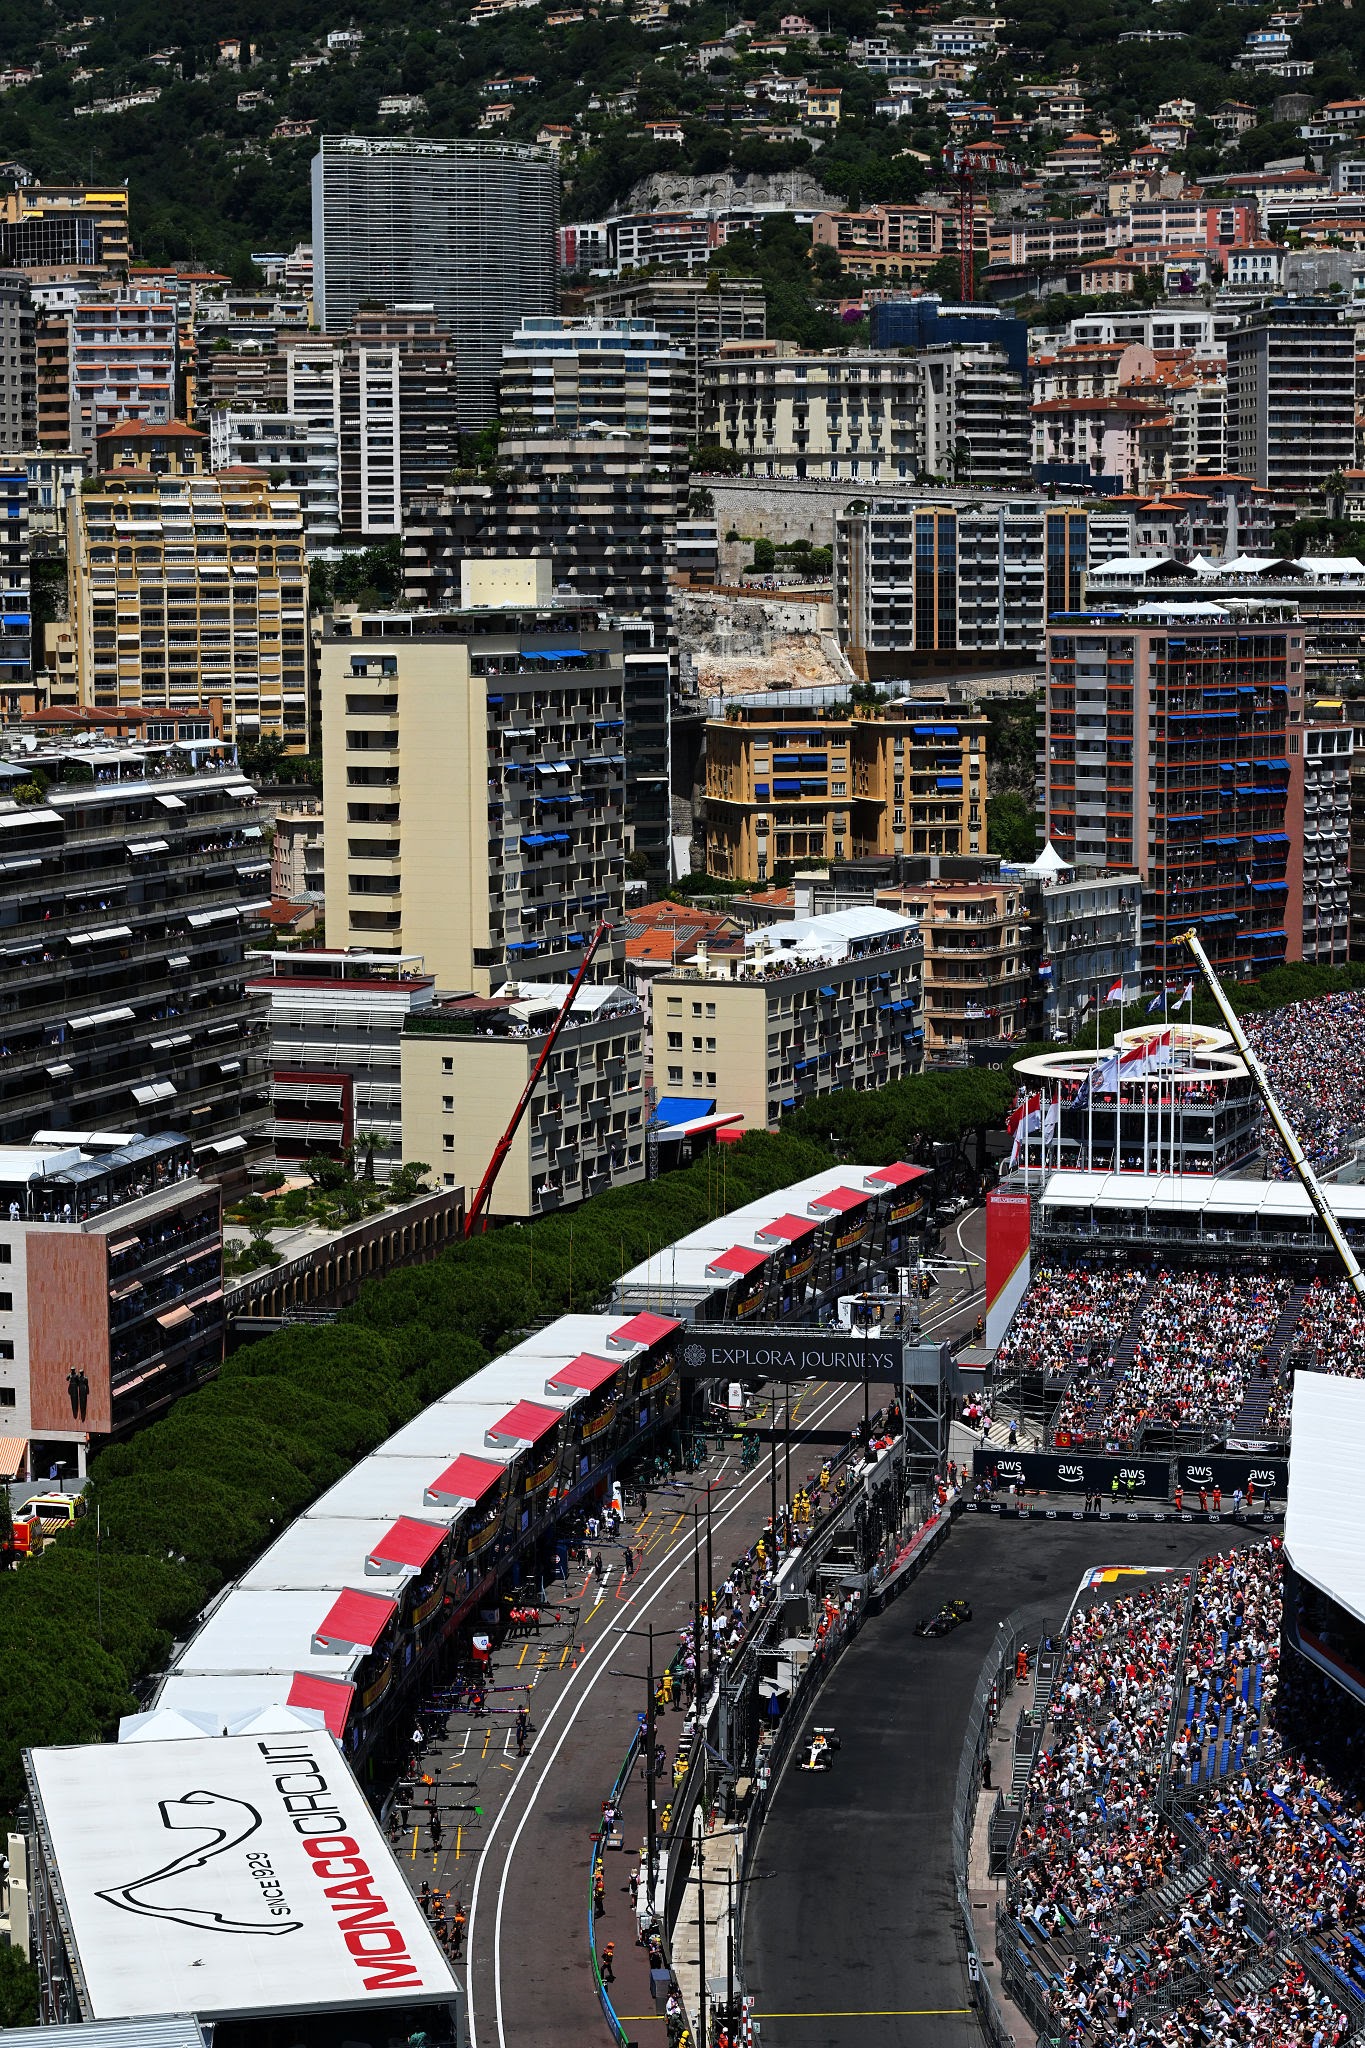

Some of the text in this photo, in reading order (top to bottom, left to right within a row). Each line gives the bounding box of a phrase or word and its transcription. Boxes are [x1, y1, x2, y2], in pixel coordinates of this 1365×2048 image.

[711, 1348, 894, 1370] EXPLORA JOURNEYS
[997, 1460, 1022, 1471] aws
[1058, 1465, 1083, 1476] aws
[1187, 1465, 1212, 1476] aws
[1120, 1468, 1145, 1480] aws
[1249, 1468, 1275, 1480] aws
[256, 1741, 424, 1991] MONACO CIRCUIT
[245, 1852, 291, 1916] SINCE 1929
